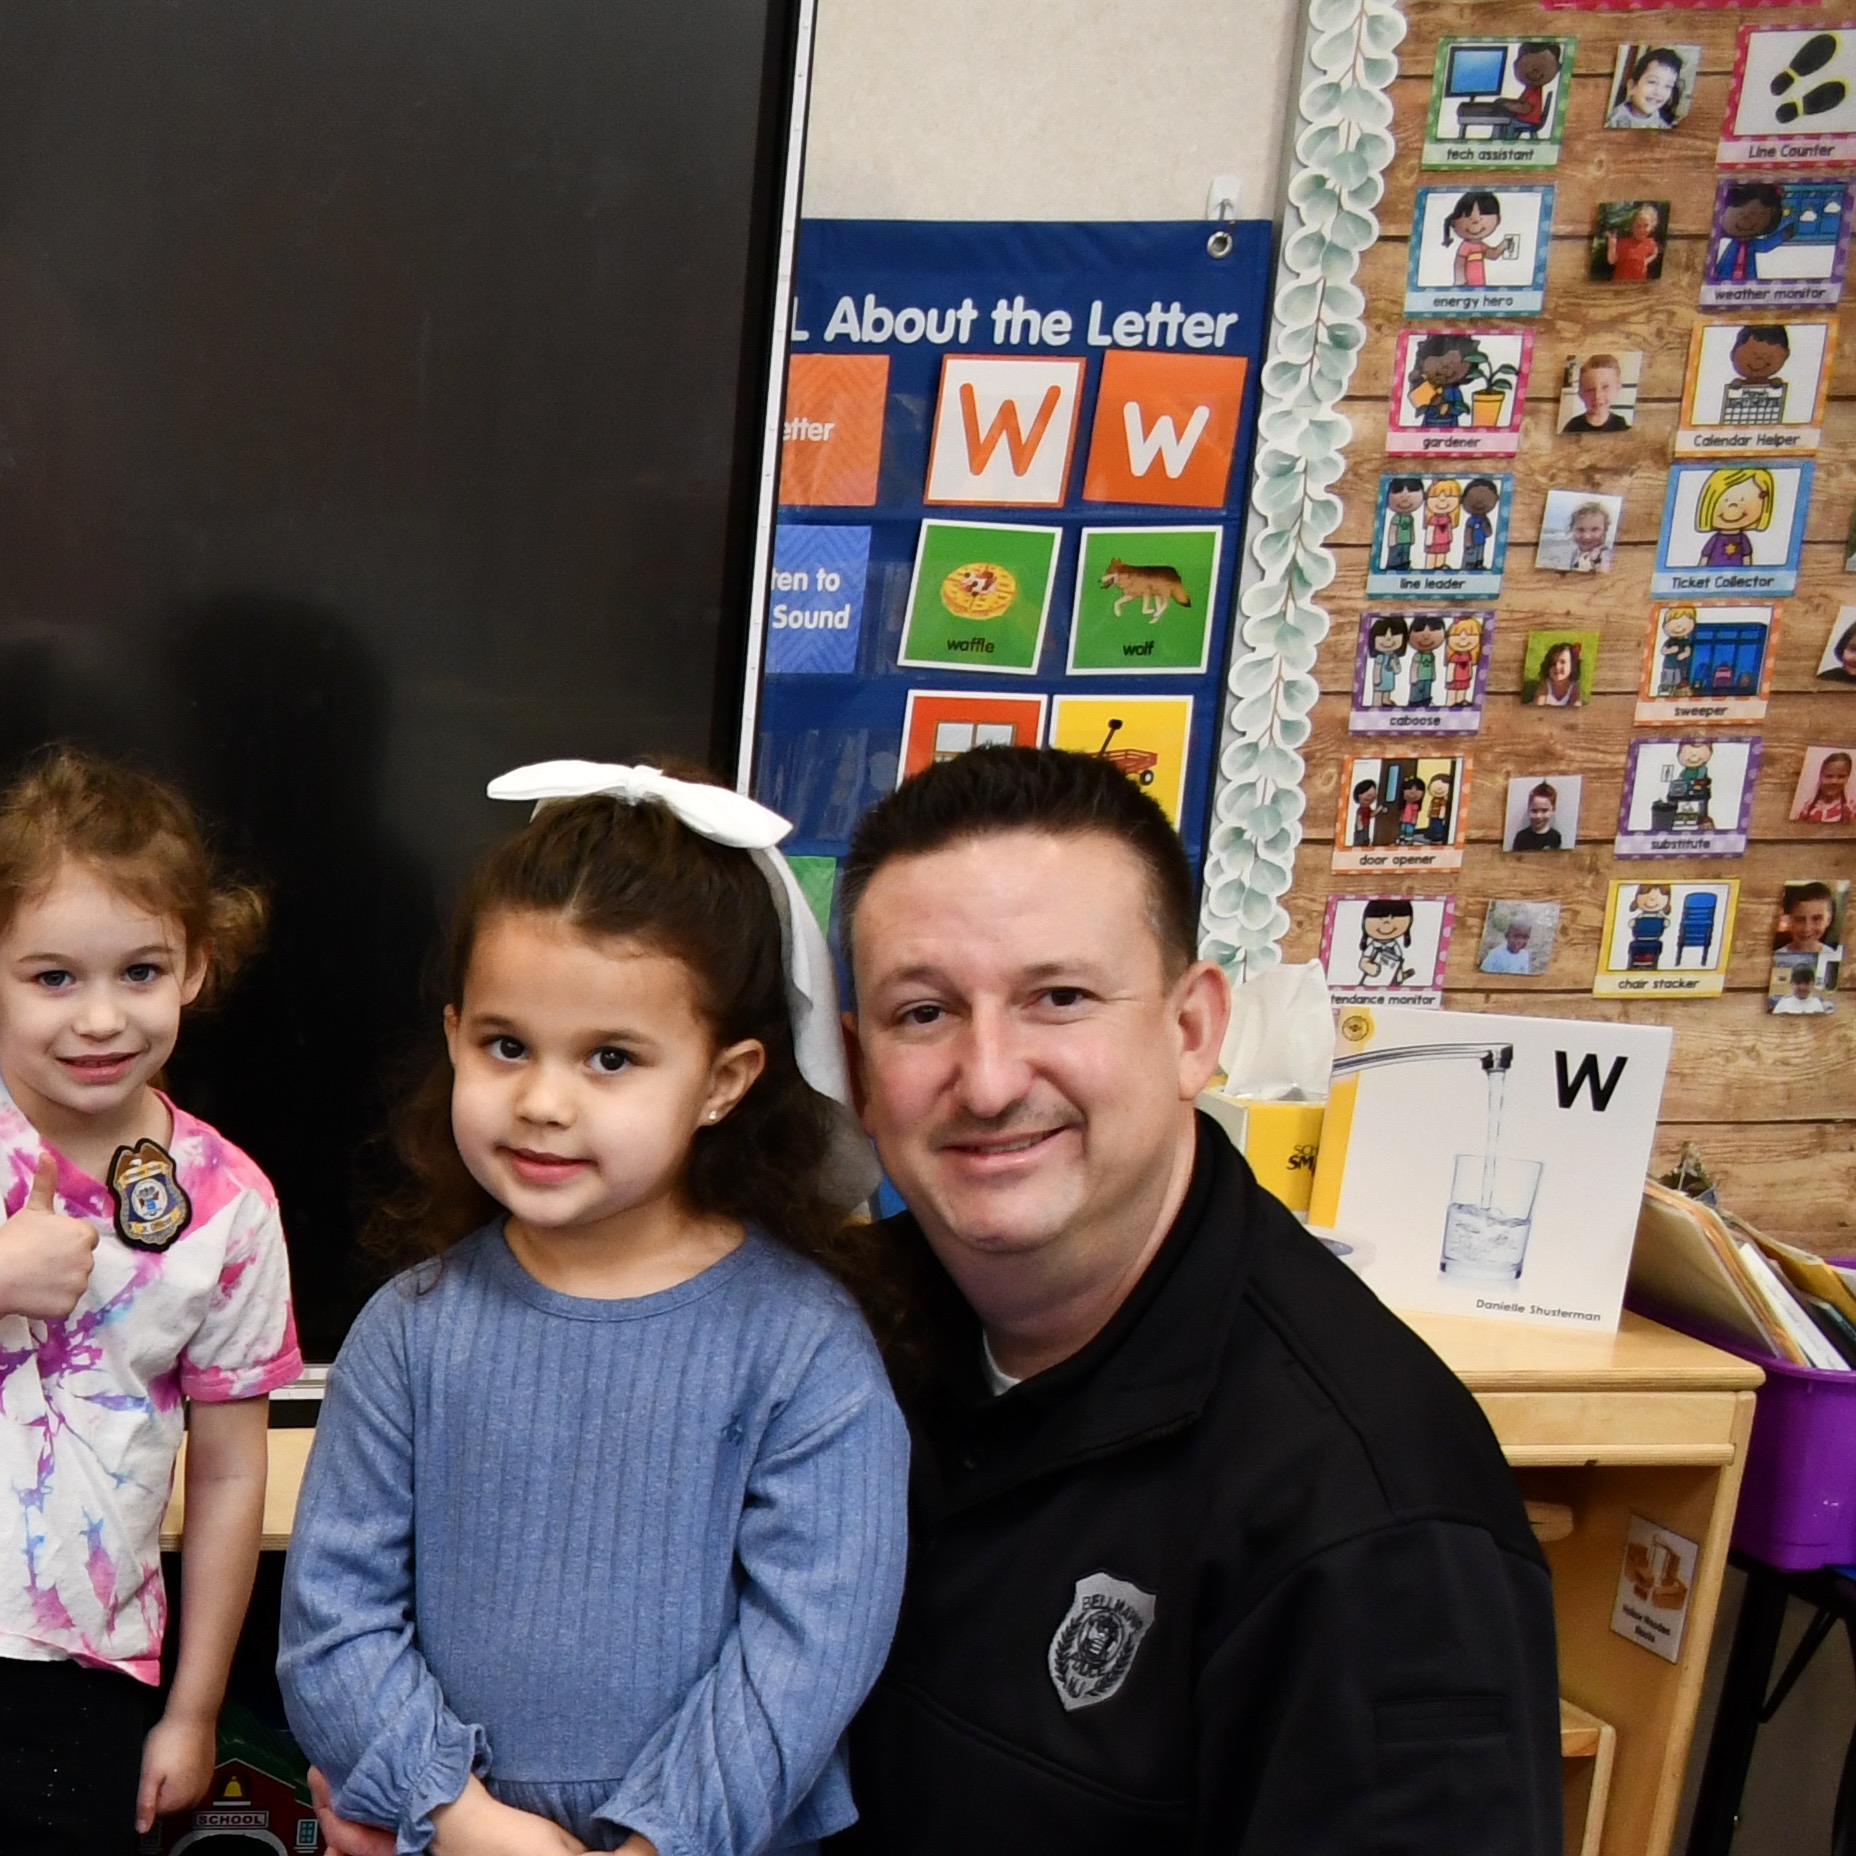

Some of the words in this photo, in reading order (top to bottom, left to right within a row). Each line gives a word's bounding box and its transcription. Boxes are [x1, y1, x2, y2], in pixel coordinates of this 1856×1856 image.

[1446, 146, 1474, 162] tech
[1477, 146, 1534, 162] assistant
[1748, 144, 1778, 159] Line
[1780, 143, 1833, 158] Counter
[1433, 296, 1479, 311] energy
[1483, 293, 1514, 307] hero
[1714, 287, 1770, 301] weather
[1773, 287, 1826, 301] monitor
[823, 293, 978, 344] About
[991, 295, 1072, 345] the
[1087, 300, 1239, 348] Letter
[959, 381, 1061, 478] W
[1422, 434, 1480, 451] gardener
[1693, 434, 1753, 447] Calendar
[1756, 433, 1801, 447] Helper
[815, 567, 841, 592] to
[1399, 577, 1423, 590] line
[1426, 576, 1466, 590] leader
[1670, 574, 1710, 589] Ticket
[1714, 573, 1775, 589] Collector
[772, 603, 851, 629] Sound
[946, 637, 996, 655] waffle
[1122, 640, 1156, 657] wolf
[1673, 704, 1729, 720] sweeper
[1389, 714, 1441, 728] caboose
[1650, 837, 1712, 850] substitute
[1358, 853, 1387, 867] door
[1392, 854, 1436, 870] opener
[1617, 977, 1649, 991] chair
[1652, 977, 1700, 991] stacker
[1387, 994, 1436, 1007] monitor
[1554, 1050, 1628, 1113] W
[1475, 1298, 1525, 1315] Danielle
[1529, 1304, 1601, 1323] Shusterman
[198, 1815, 263, 1825] SCHOOL
